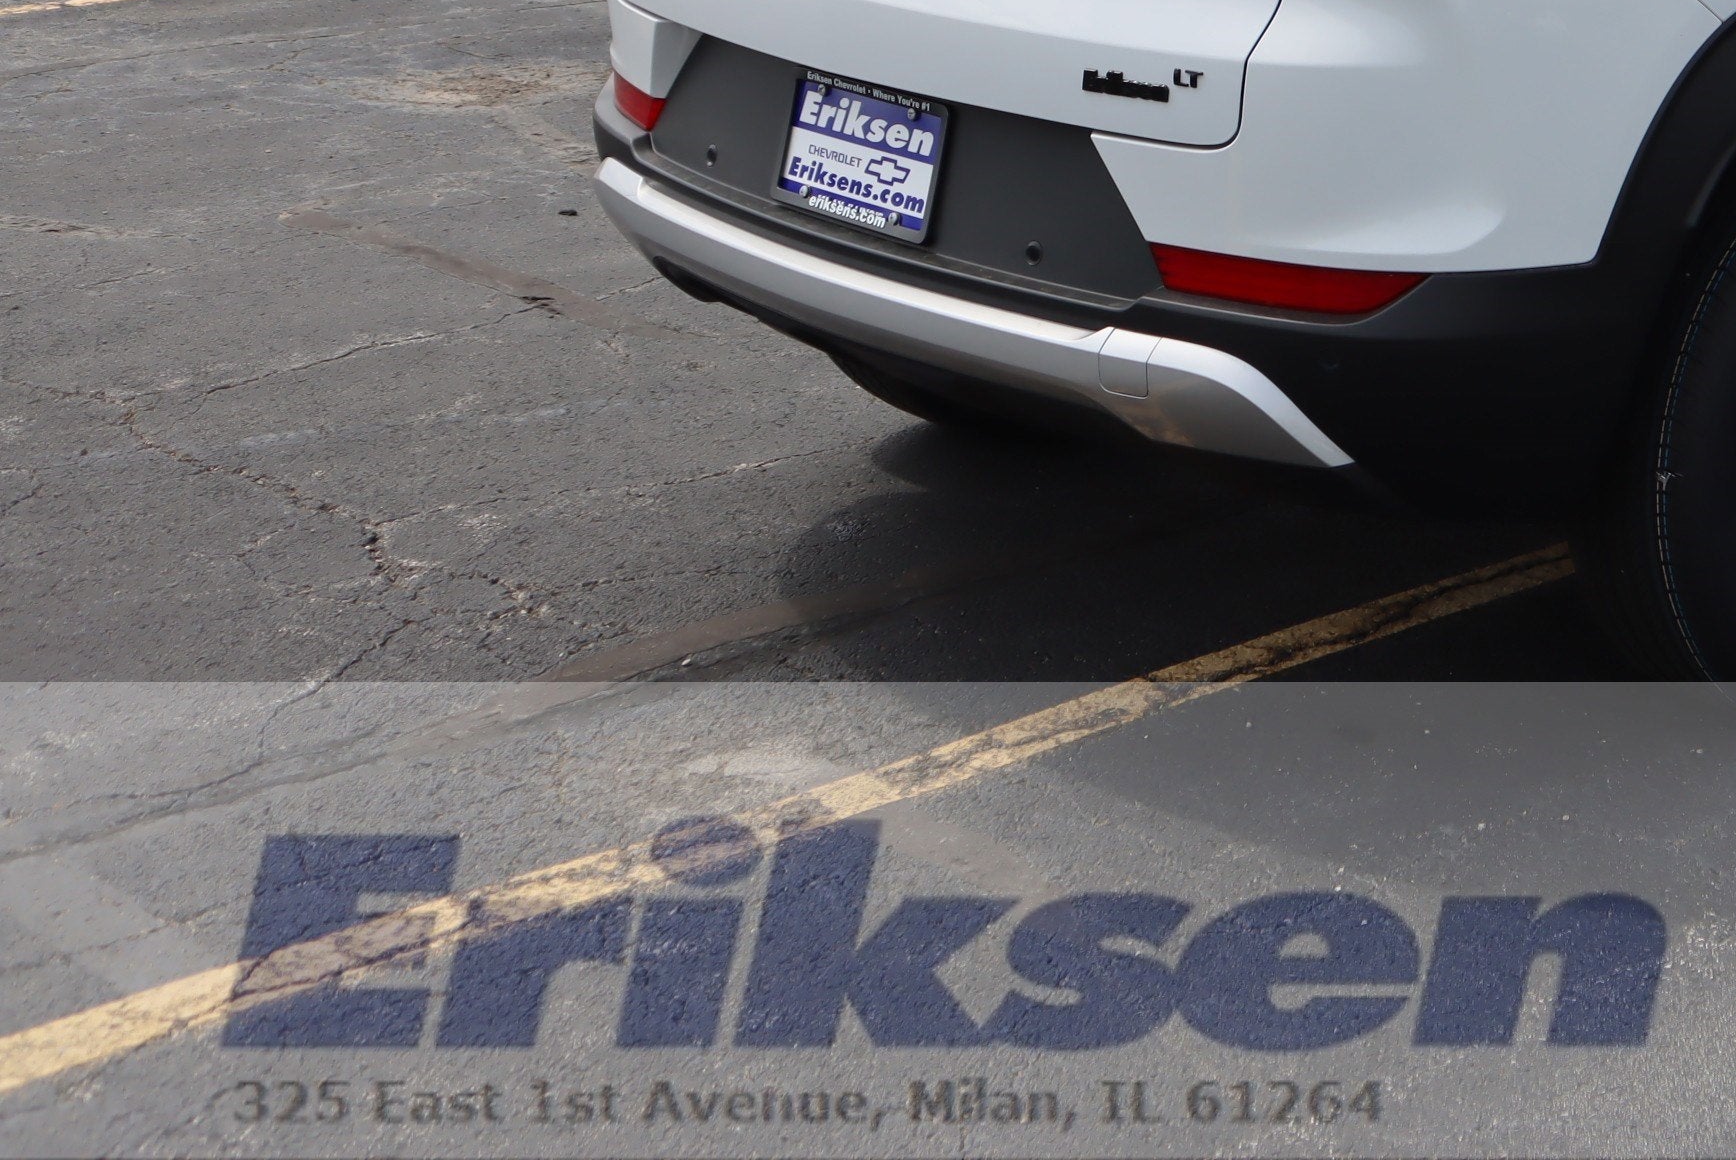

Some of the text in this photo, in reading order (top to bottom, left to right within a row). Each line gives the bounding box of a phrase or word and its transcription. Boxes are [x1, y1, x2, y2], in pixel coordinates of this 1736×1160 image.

[807, 70, 833, 85] Eriksen
[833, 78, 867, 94] Chevrolet
[872, 88, 896, 102] Where
[1173, 68, 1204, 88] LT
[799, 89, 935, 157] Eriksen
[808, 144, 863, 168] CHEVROLET
[788, 156, 925, 214] Eriksens.com
[808, 195, 887, 229] eriksens.com
